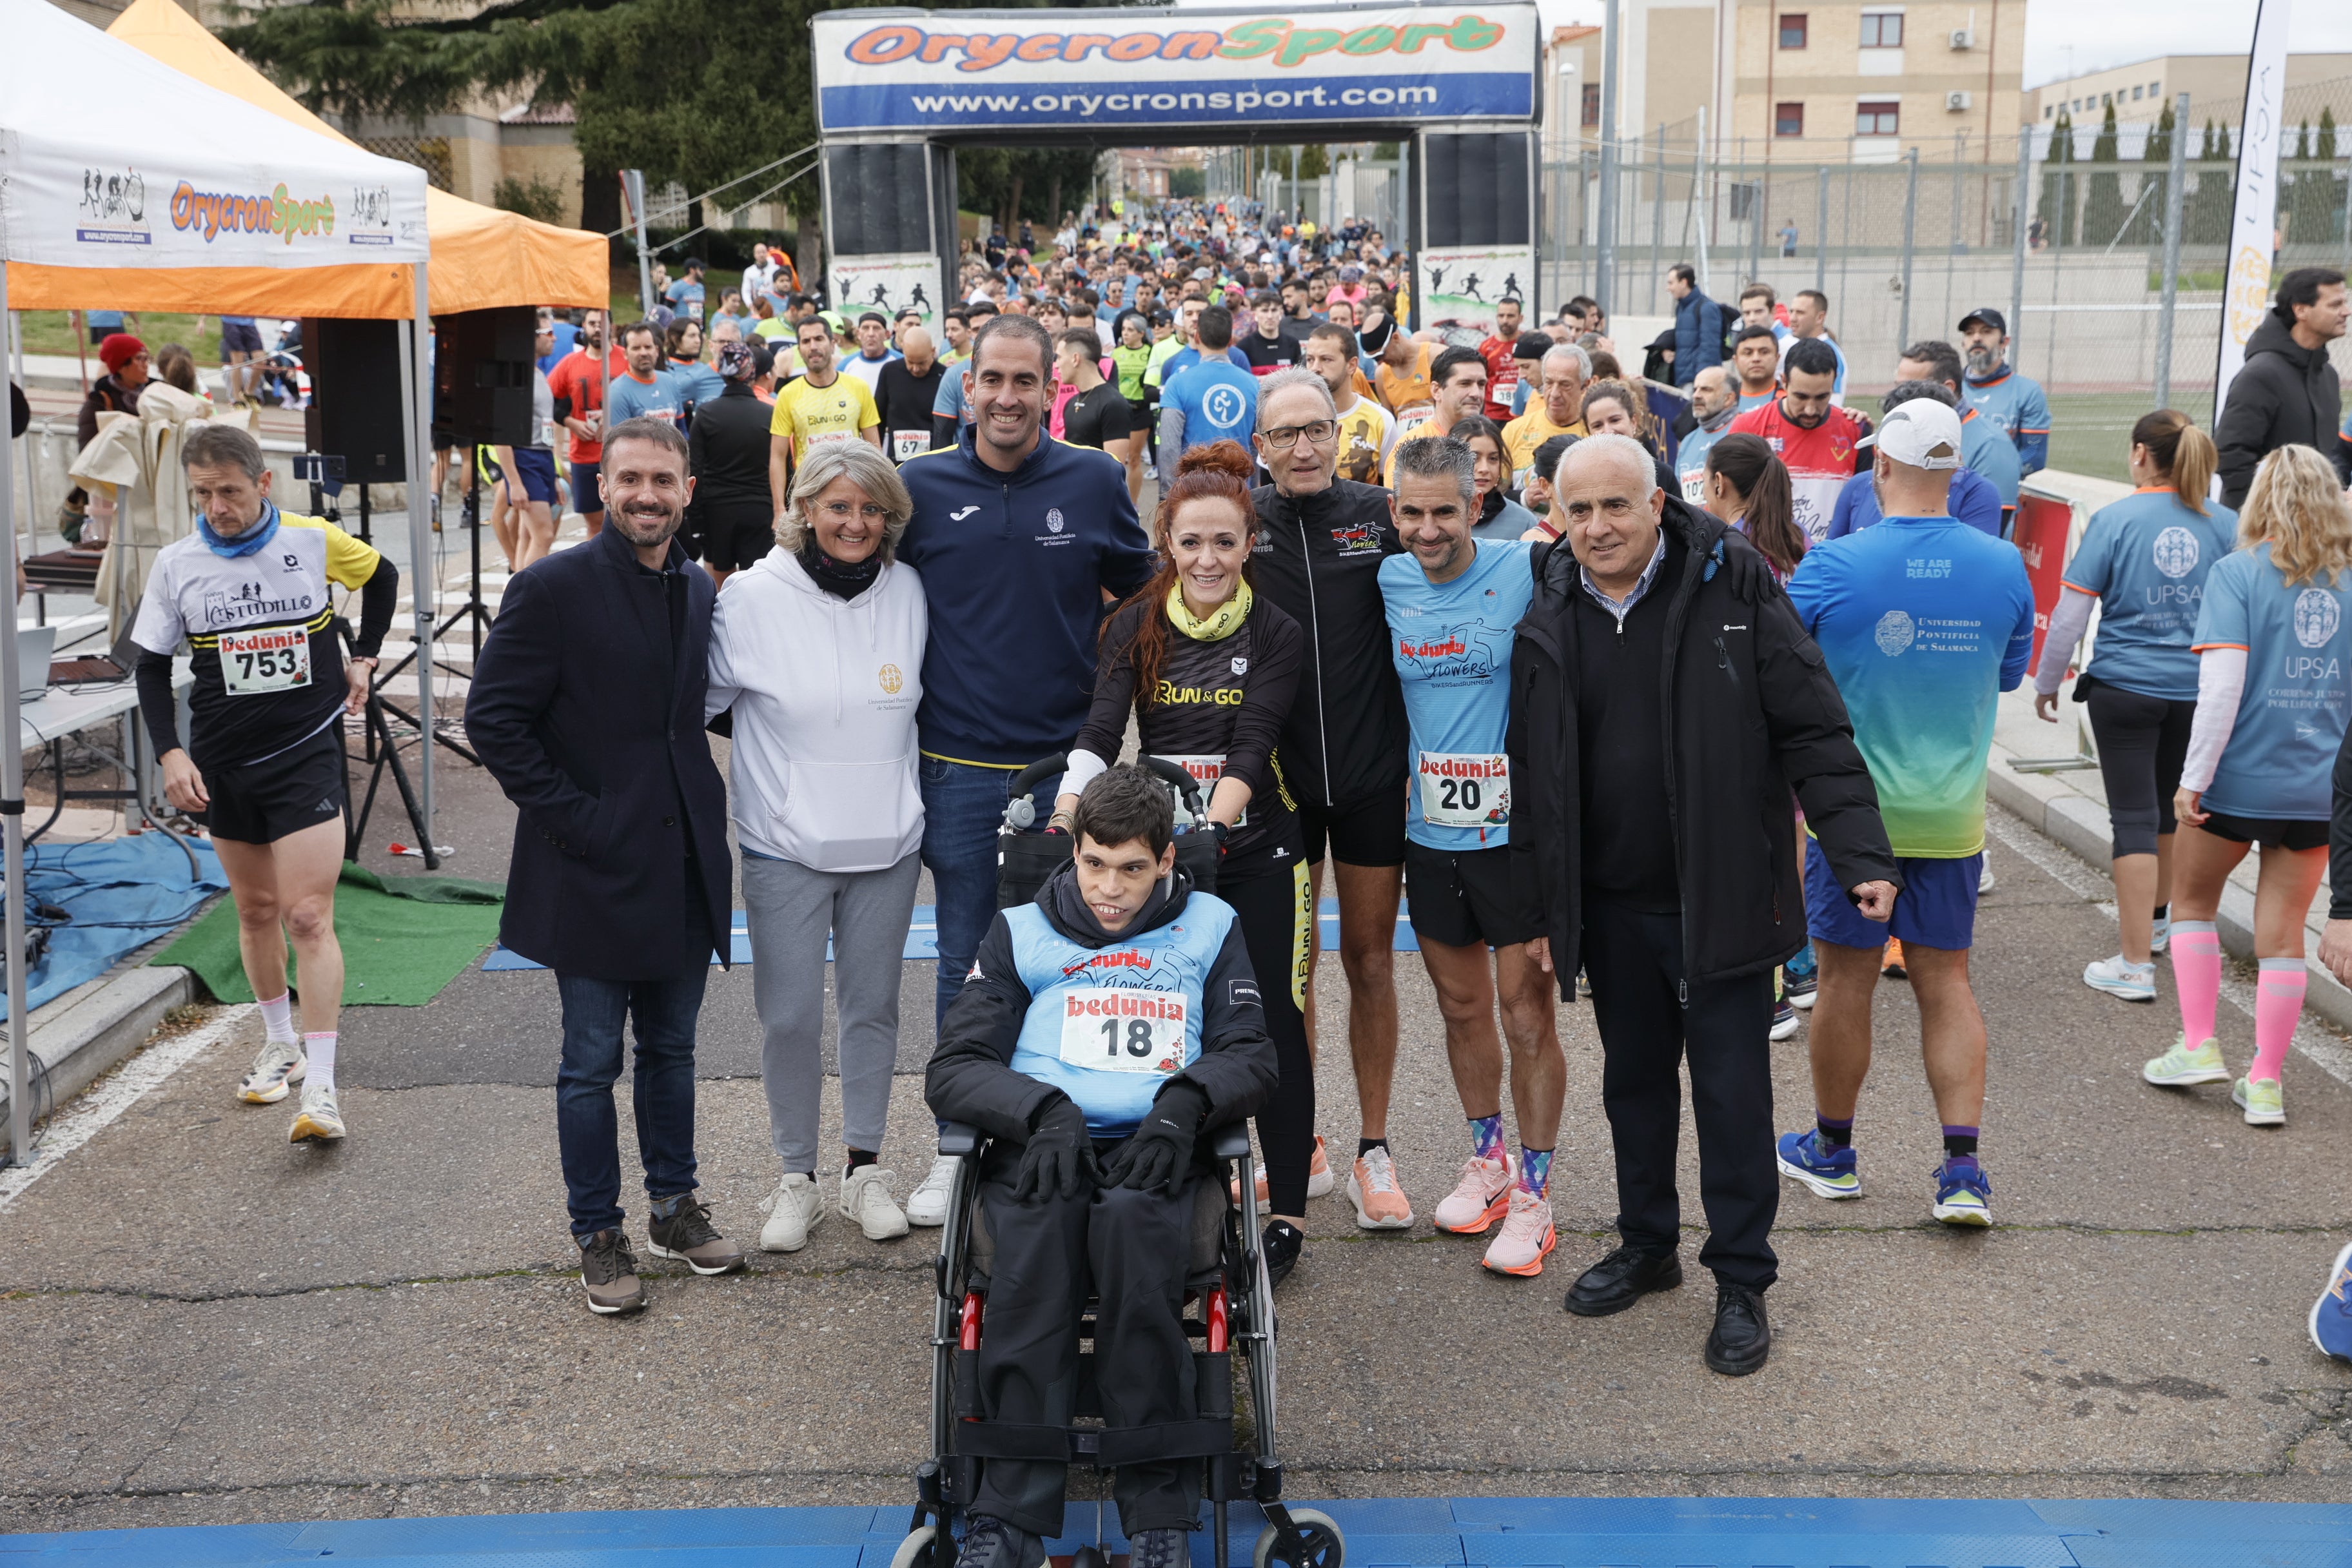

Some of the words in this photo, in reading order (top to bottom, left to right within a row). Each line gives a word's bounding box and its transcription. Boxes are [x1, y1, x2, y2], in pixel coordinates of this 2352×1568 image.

[845, 15, 1505, 72] OrycronSport
[912, 84, 1437, 116] www.orycronsport.com
[171, 180, 334, 245] OrycronSport
[902, 441, 917, 453] 67
[1906, 559, 1925, 568] WE
[1927, 560, 1952, 568] ARE
[1906, 569, 1952, 578] READY
[2146, 584, 2202, 605] UPSA
[235, 649, 297, 680] 753
[1432, 662, 1486, 678] FLOWERS
[2285, 656, 2340, 680] UPSA
[1153, 680, 1201, 705] RUN
[1202, 691, 1212, 701] &
[1215, 689, 1243, 705] GO
[1431, 679, 1494, 689] BIKERSandRUNNERS
[1420, 759, 1507, 778] bedunia
[1440, 779, 1481, 810] 20
[1303, 882, 1311, 912] GO
[1067, 994, 1184, 1021] bedunia
[1101, 1019, 1153, 1058] 18
